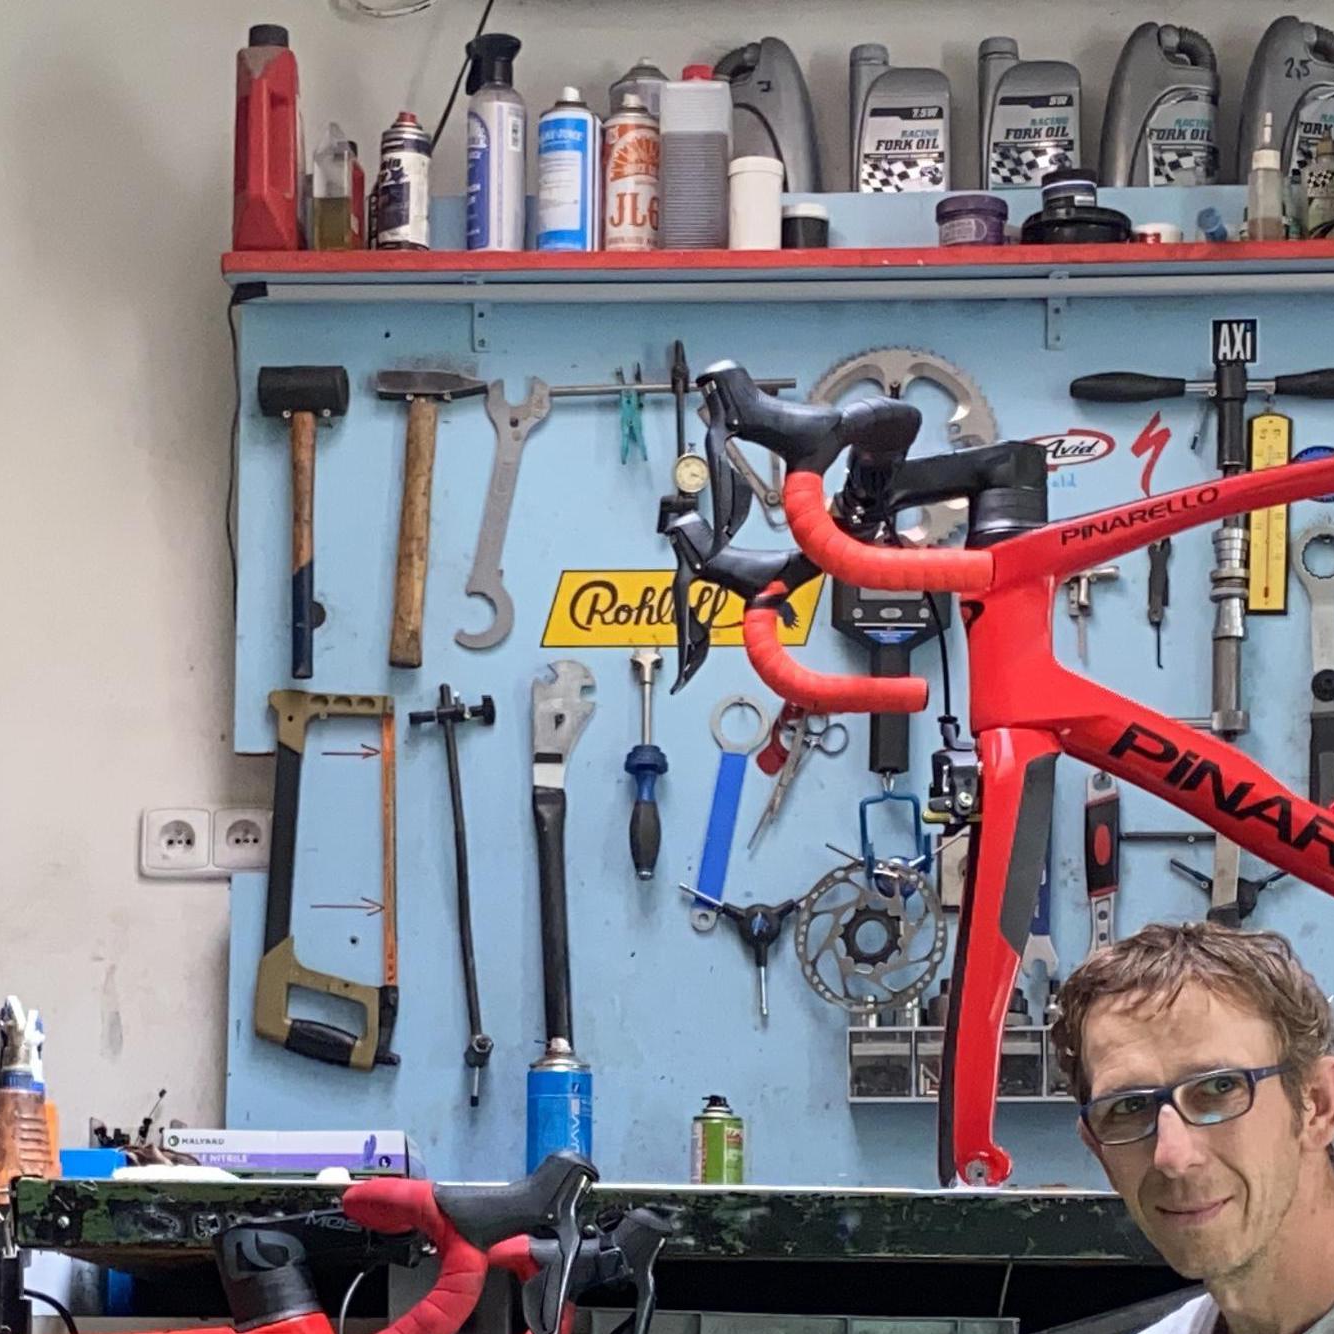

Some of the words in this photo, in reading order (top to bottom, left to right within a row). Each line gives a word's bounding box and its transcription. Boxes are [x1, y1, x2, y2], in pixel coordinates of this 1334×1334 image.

[1004, 128, 1041, 140] FORK
[1046, 126, 1069, 138] OIL
[1149, 128, 1187, 141] FORK
[876, 139, 913, 151] FORK
[916, 138, 939, 149] OIL
[1218, 322, 1251, 361] AXi
[1044, 439, 1098, 459] Avid
[1060, 486, 1219, 546] PINARELLO
